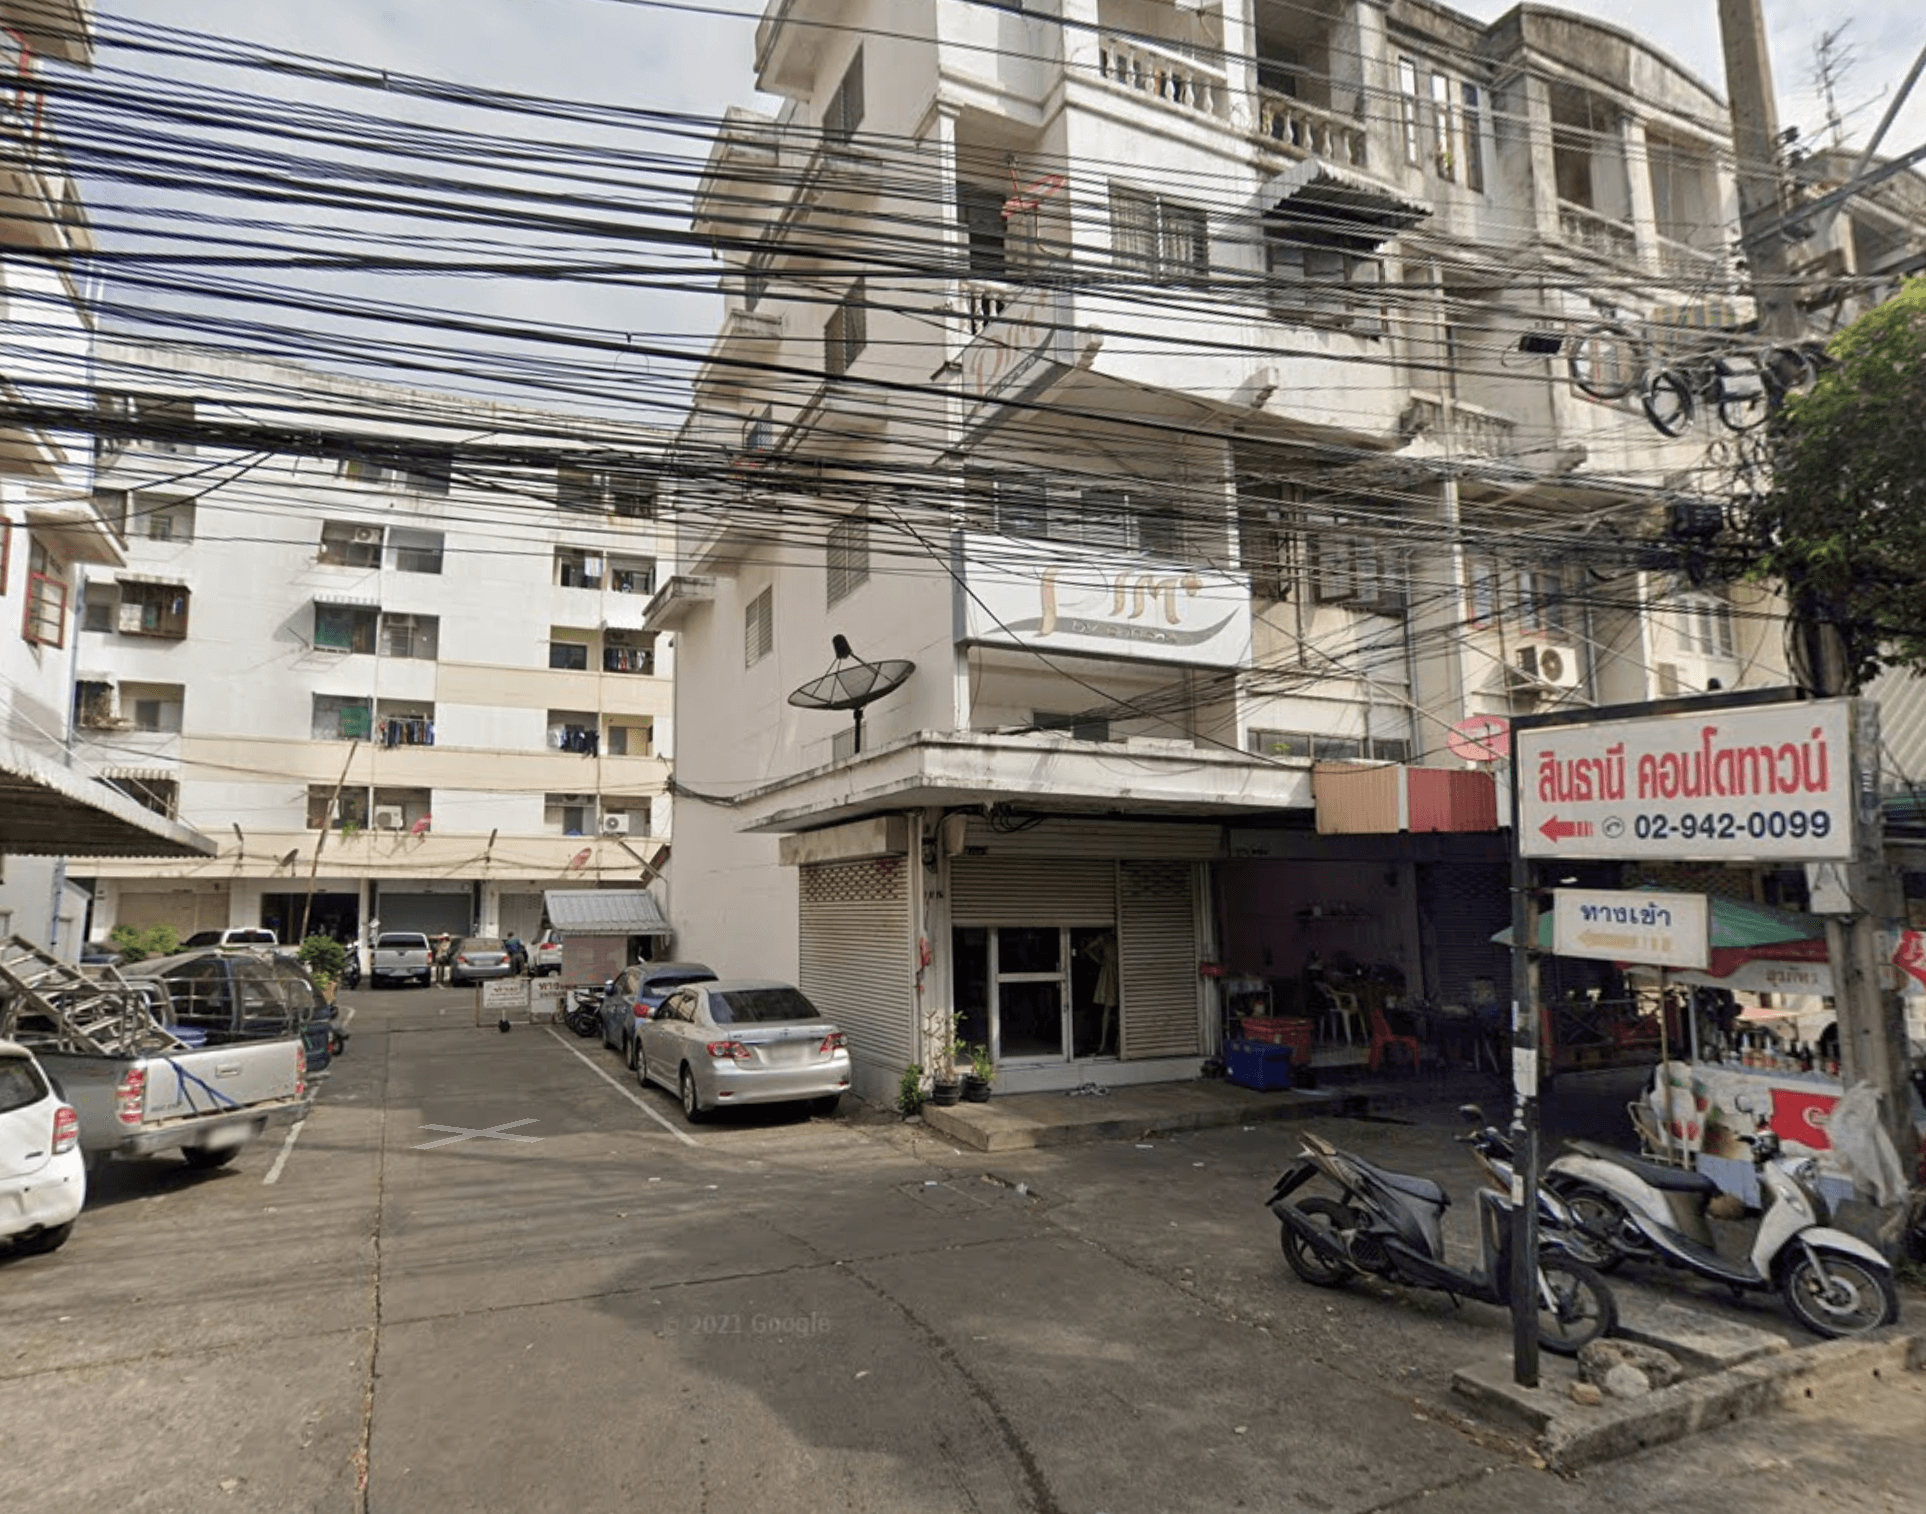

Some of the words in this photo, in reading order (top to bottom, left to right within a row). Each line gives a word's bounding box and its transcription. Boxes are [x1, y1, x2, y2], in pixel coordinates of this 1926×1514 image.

[1538, 742, 1626, 803] สินธานี
[1637, 726, 1829, 800] คอนโดทาวน์
[1634, 809, 1831, 840] 02-942-0099
[1580, 901, 1671, 927] ทางเข้า
